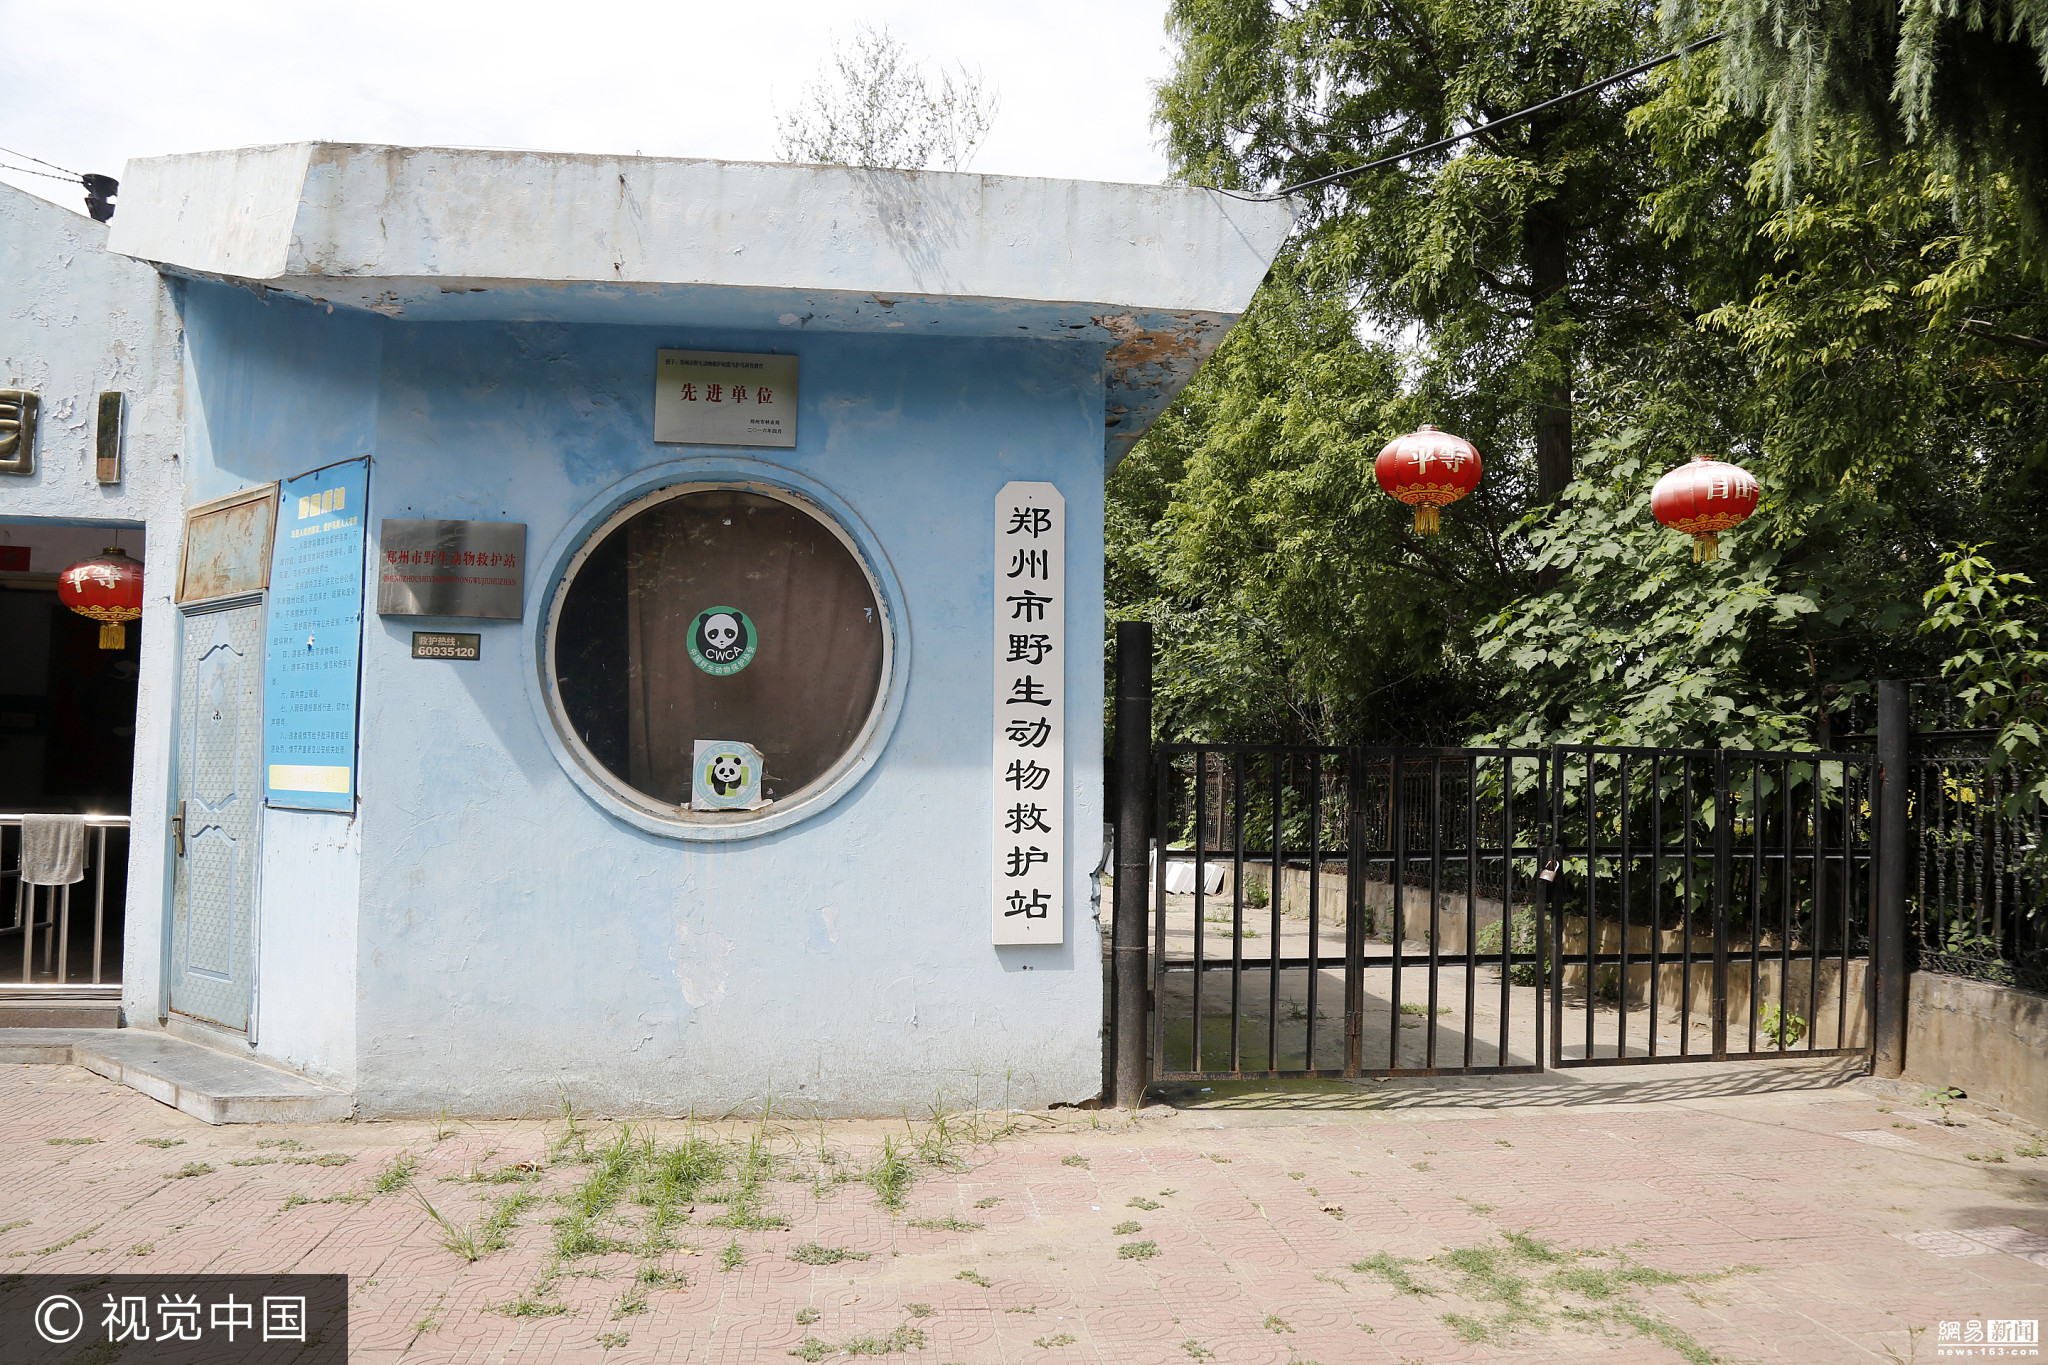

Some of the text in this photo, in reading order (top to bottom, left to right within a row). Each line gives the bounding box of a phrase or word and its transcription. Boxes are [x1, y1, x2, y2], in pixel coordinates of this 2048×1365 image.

[680, 382, 774, 405] 先进单位
[1407, 446, 1466, 475] 平等
[386, 550, 516, 568] 郑州市野生动物救护站
[67, 565, 123, 594] 平等
[418, 646, 475, 657] 60935120
[690, 645, 755, 674] 中国野生动物保护协会
[705, 646, 743, 661] CWCA
[1004, 506, 1053, 919] 郑州市野生动物救护站
